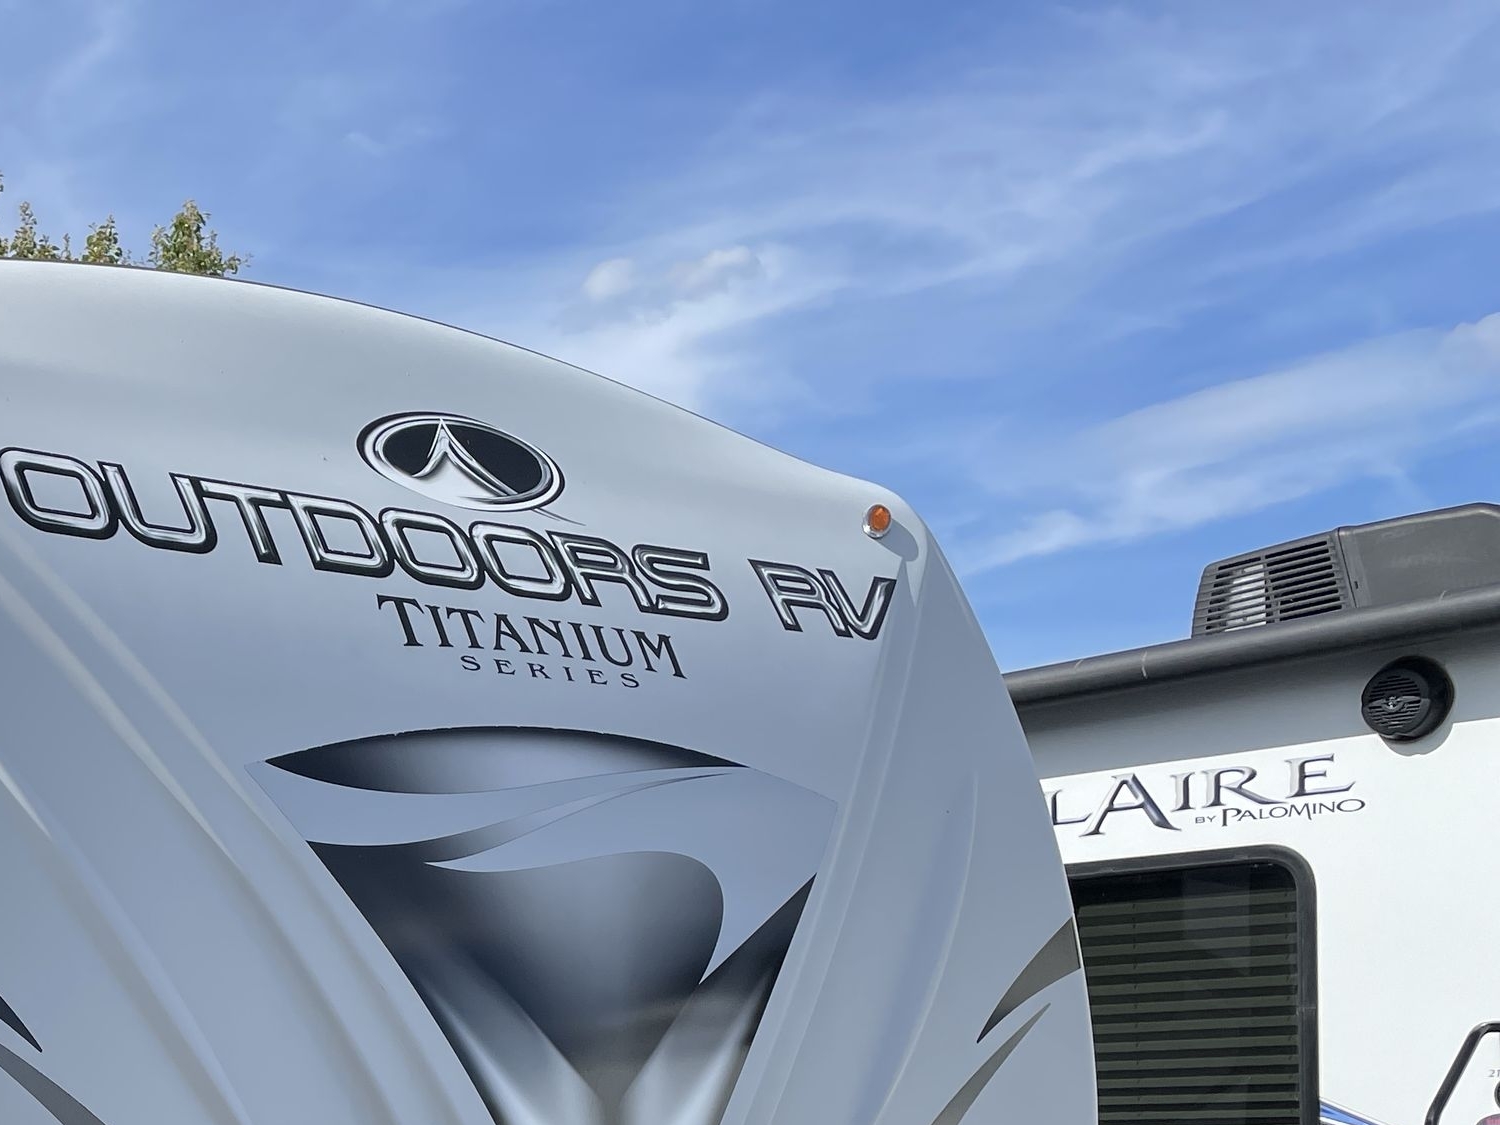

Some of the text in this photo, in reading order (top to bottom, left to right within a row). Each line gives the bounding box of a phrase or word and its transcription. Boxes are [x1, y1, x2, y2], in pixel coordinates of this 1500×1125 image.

[376, 594, 688, 680] TITANIUM
[746, 557, 897, 640] RV
[460, 654, 641, 690] SERIES
[1045, 753, 1355, 838] LAIRE
[1194, 797, 1366, 828] BY PALOMINO
